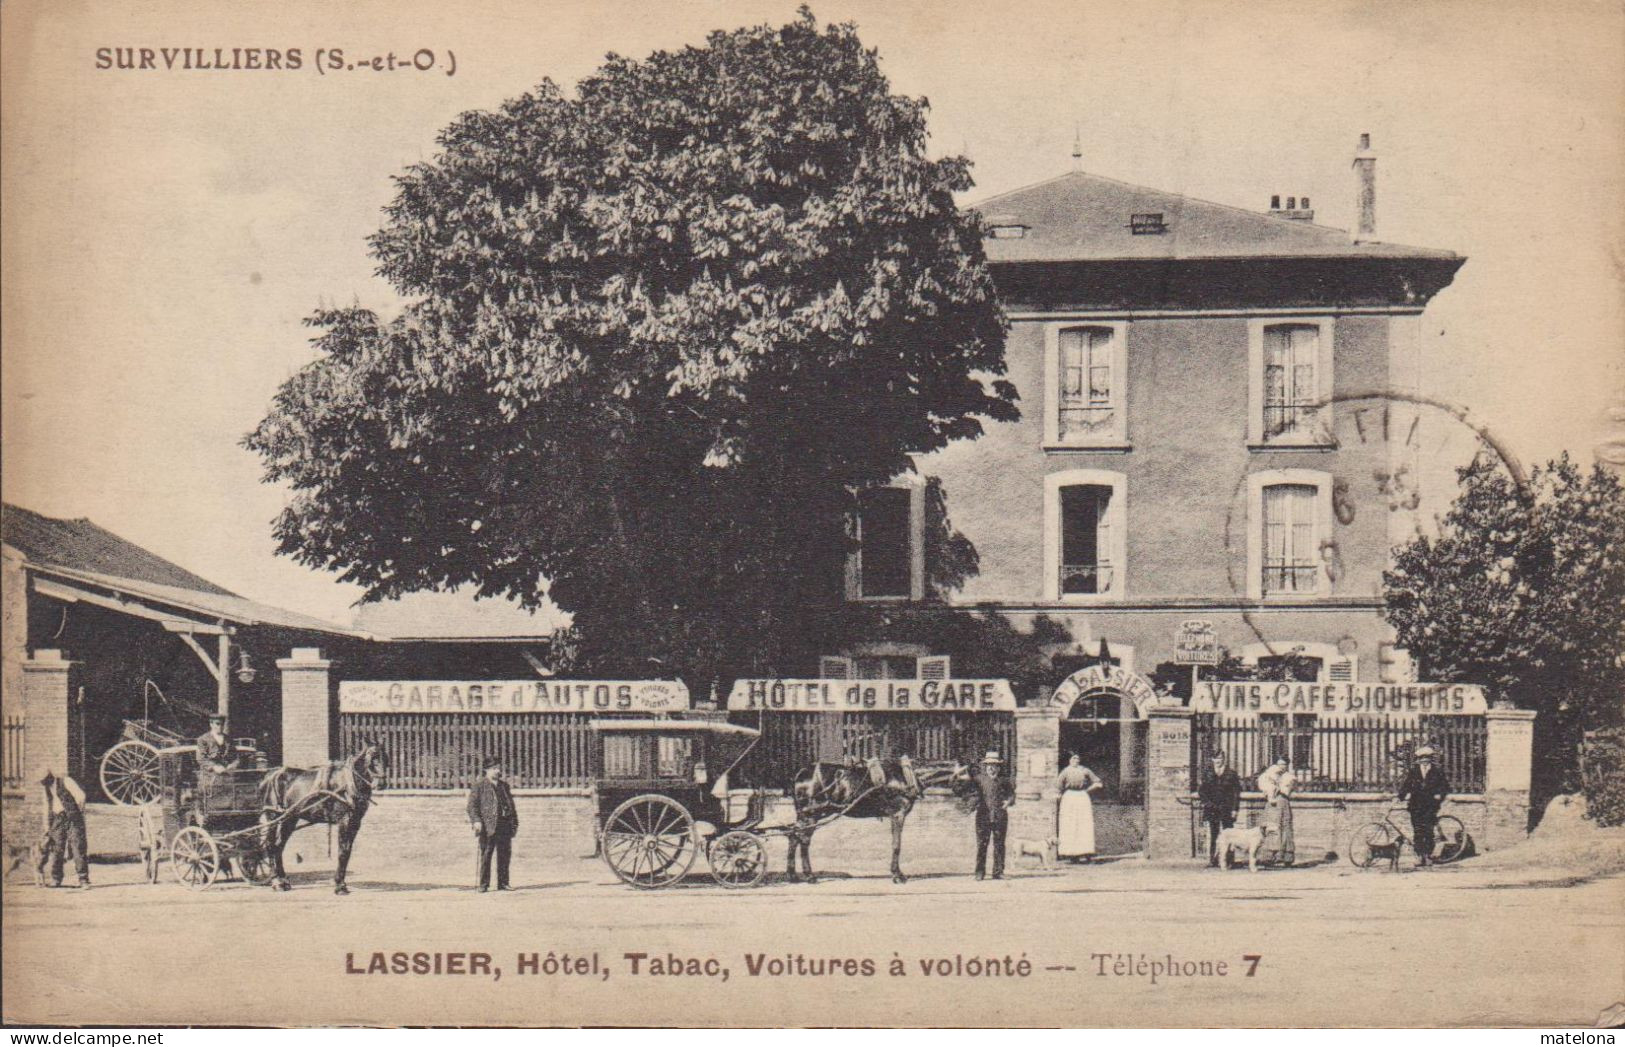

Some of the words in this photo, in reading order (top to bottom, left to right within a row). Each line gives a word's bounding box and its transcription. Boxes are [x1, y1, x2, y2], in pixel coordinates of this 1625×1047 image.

[387, 683, 503, 710] GARAGE
[511, 682, 631, 710] d'AUTOS
[747, 680, 835, 709] HÔTEL
[846, 683, 877, 708] de
[888, 683, 909, 708] la
[919, 680, 995, 709] GARE
[1206, 683, 1261, 711] VINS
[1346, 683, 1464, 713] LIQUEURS
